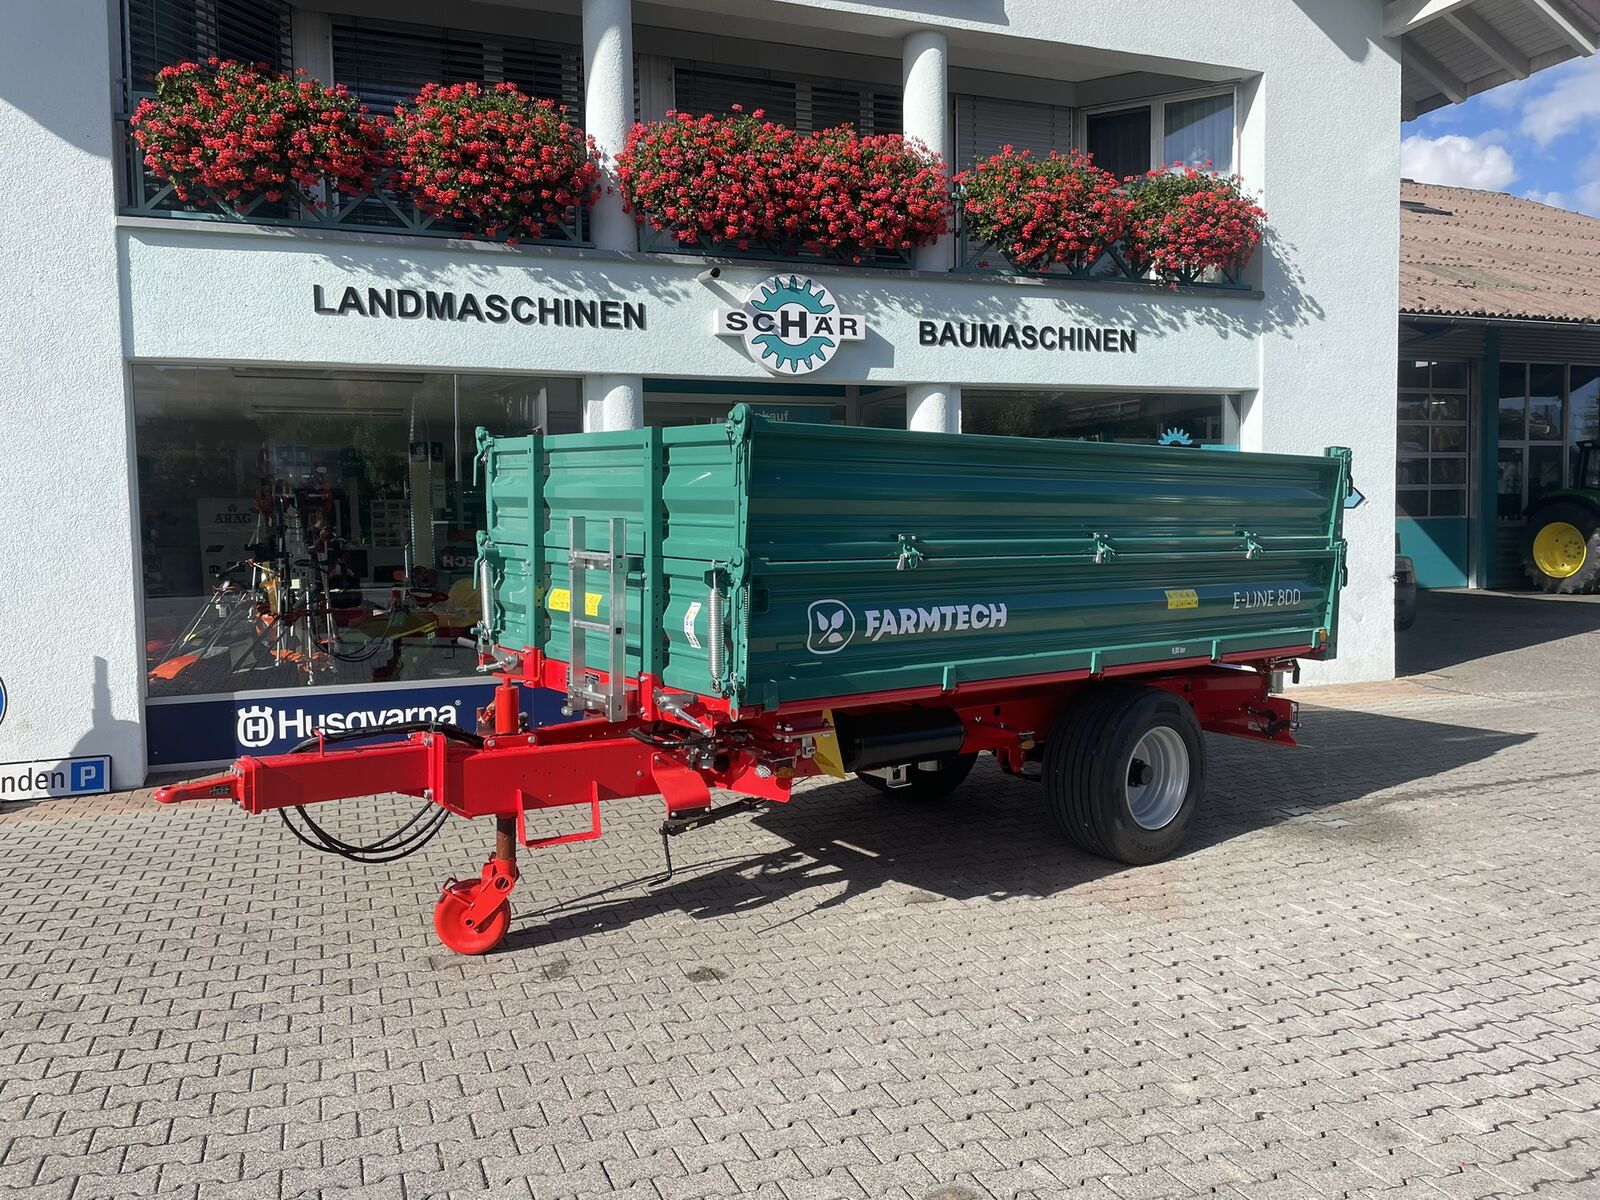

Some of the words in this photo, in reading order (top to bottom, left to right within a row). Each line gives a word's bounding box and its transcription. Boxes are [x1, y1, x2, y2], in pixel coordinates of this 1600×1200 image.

[313, 284, 646, 330] LANDMASCHINEN
[726, 310, 858, 338] SCHÄR
[919, 320, 1137, 353] BAUMASCHINEN
[1232, 591, 1274, 609] E-LINE
[1277, 588, 1301, 606] 800
[864, 603, 1008, 641] FARMTECH
[278, 704, 457, 740] Husqvarna
[1, 767, 65, 793] nden
[80, 765, 96, 787] P
